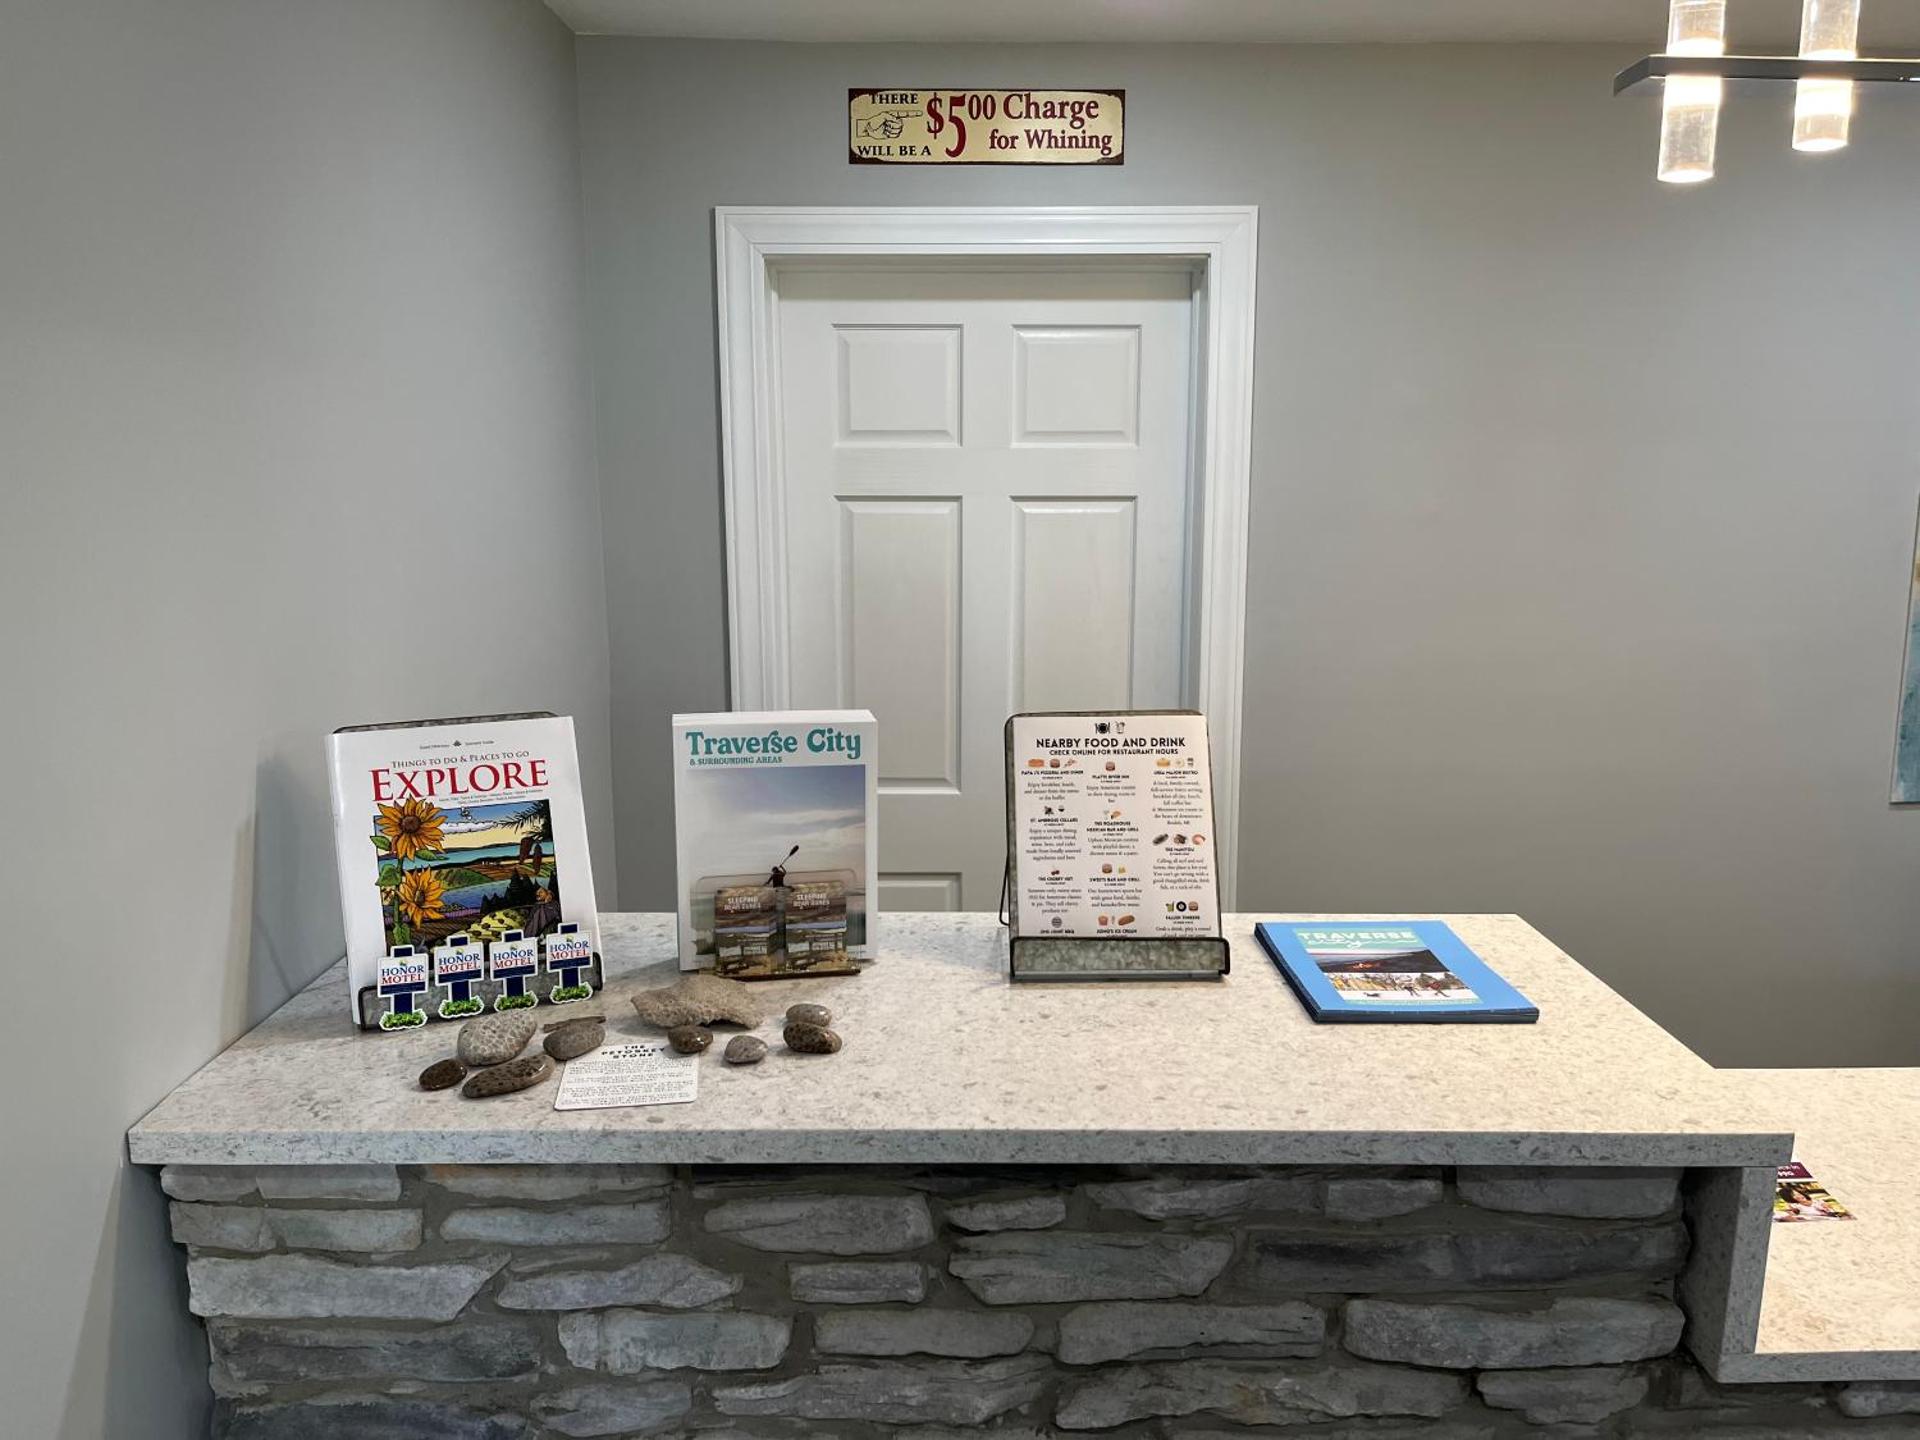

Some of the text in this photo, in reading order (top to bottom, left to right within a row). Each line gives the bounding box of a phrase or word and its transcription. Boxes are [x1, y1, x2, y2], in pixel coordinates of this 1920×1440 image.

[868, 94, 919, 105] THERE
[1003, 92, 1099, 130] Charge
[989, 129, 1113, 156] for Whining
[857, 145, 932, 157] WILL BE A
[686, 727, 861, 760] Traverse City
[1036, 737, 1186, 748] NEARBY FOOD AND DRINK
[391, 759, 427, 769] THINGS
[429, 758, 441, 766] TO
[443, 757, 458, 765] DO
[469, 753, 501, 763] PLACES
[698, 757, 754, 765] SURROUNDING
[755, 756, 783, 764] AREAS
[368, 760, 549, 802] EXPLORE
[550, 941, 589, 952] HONOR
[438, 953, 480, 965] HONOR
[493, 948, 534, 960] HONOR
[550, 949, 588, 960] MOTEL
[439, 962, 480, 974] MOTEL
[493, 957, 533, 969] MOTEL
[381, 964, 424, 976] HONOR
[382, 973, 424, 985] MOTEL
